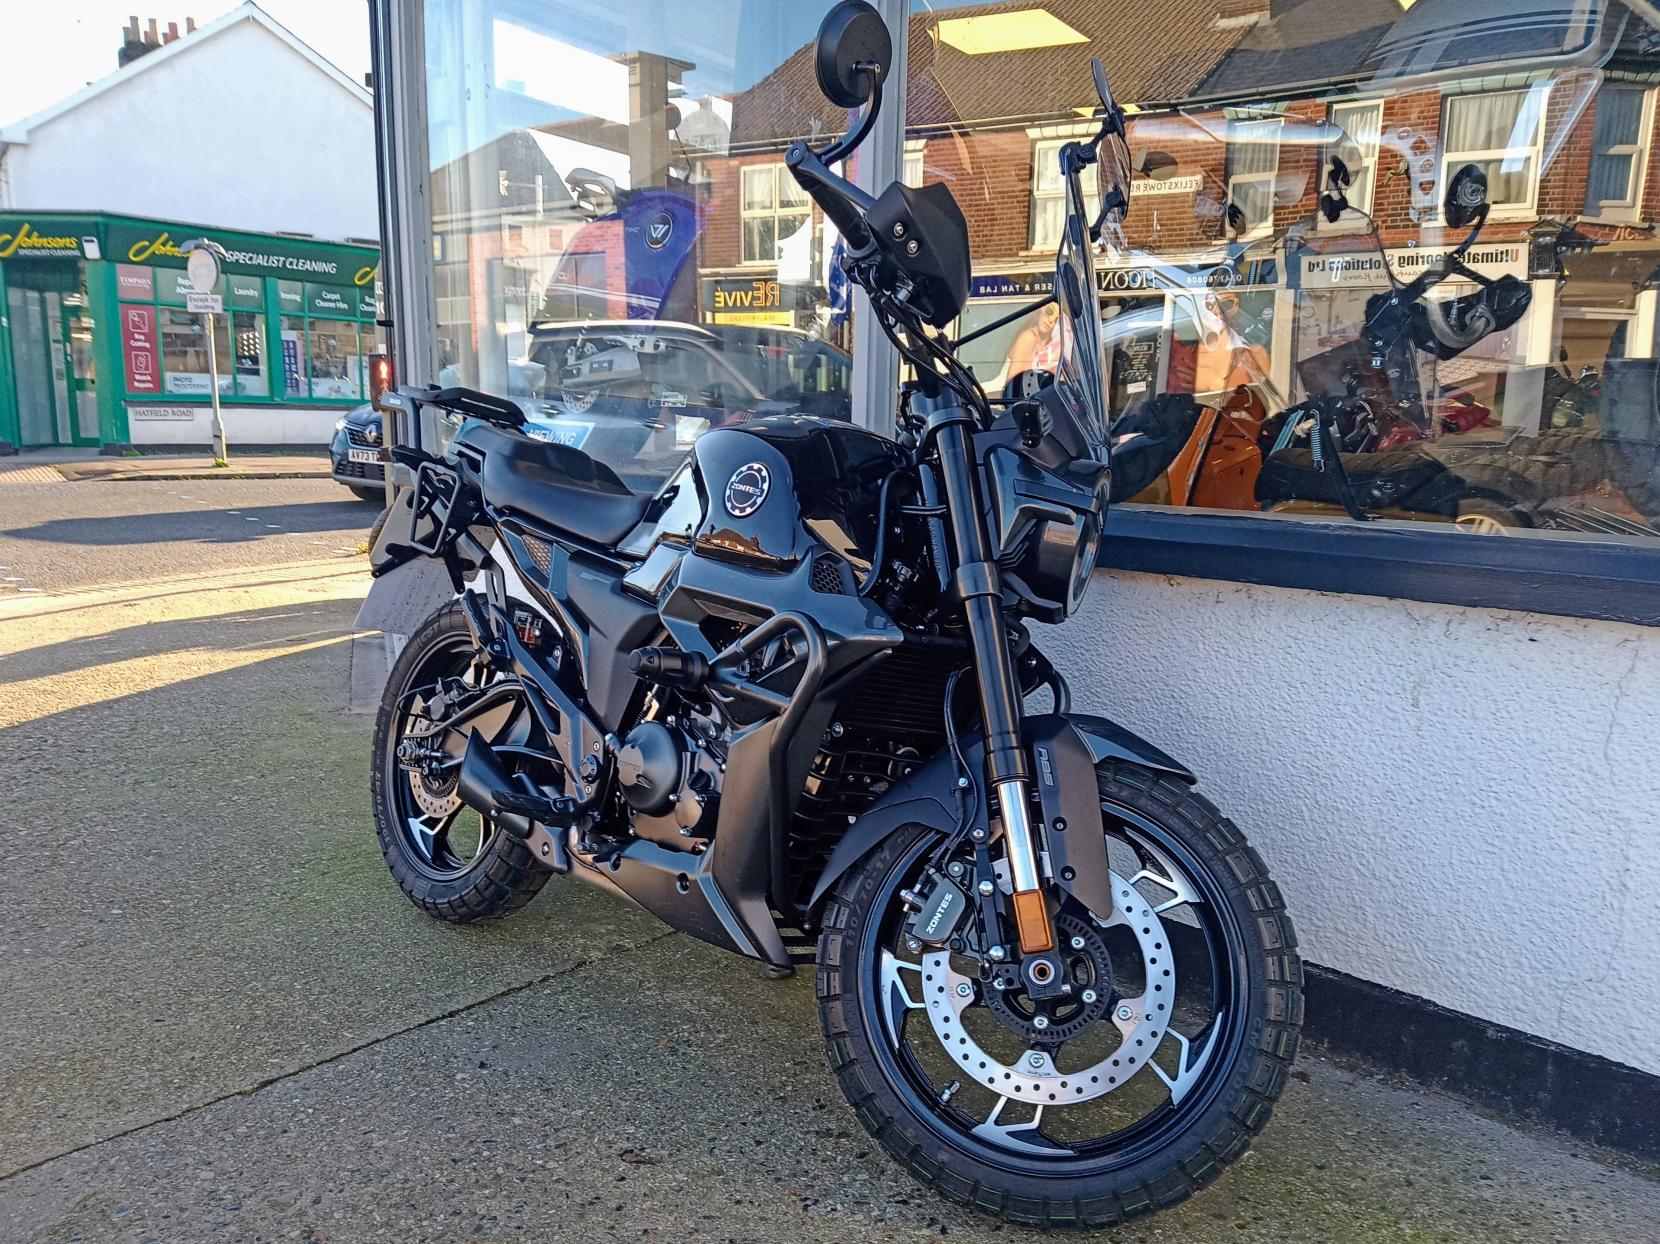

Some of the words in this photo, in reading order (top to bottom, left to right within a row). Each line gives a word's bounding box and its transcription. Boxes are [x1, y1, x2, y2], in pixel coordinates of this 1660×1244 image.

[0, 222, 79, 257] Johnsons
[226, 250, 285, 269] SPECIALIST
[286, 257, 338, 274] CLEANING
[135, 409, 170, 417] HATFIELD
[171, 409, 192, 418] ROAD
[731, 482, 761, 496] ZONTES
[1038, 747, 1055, 787] ABS
[926, 892, 953, 935] ZONTES
